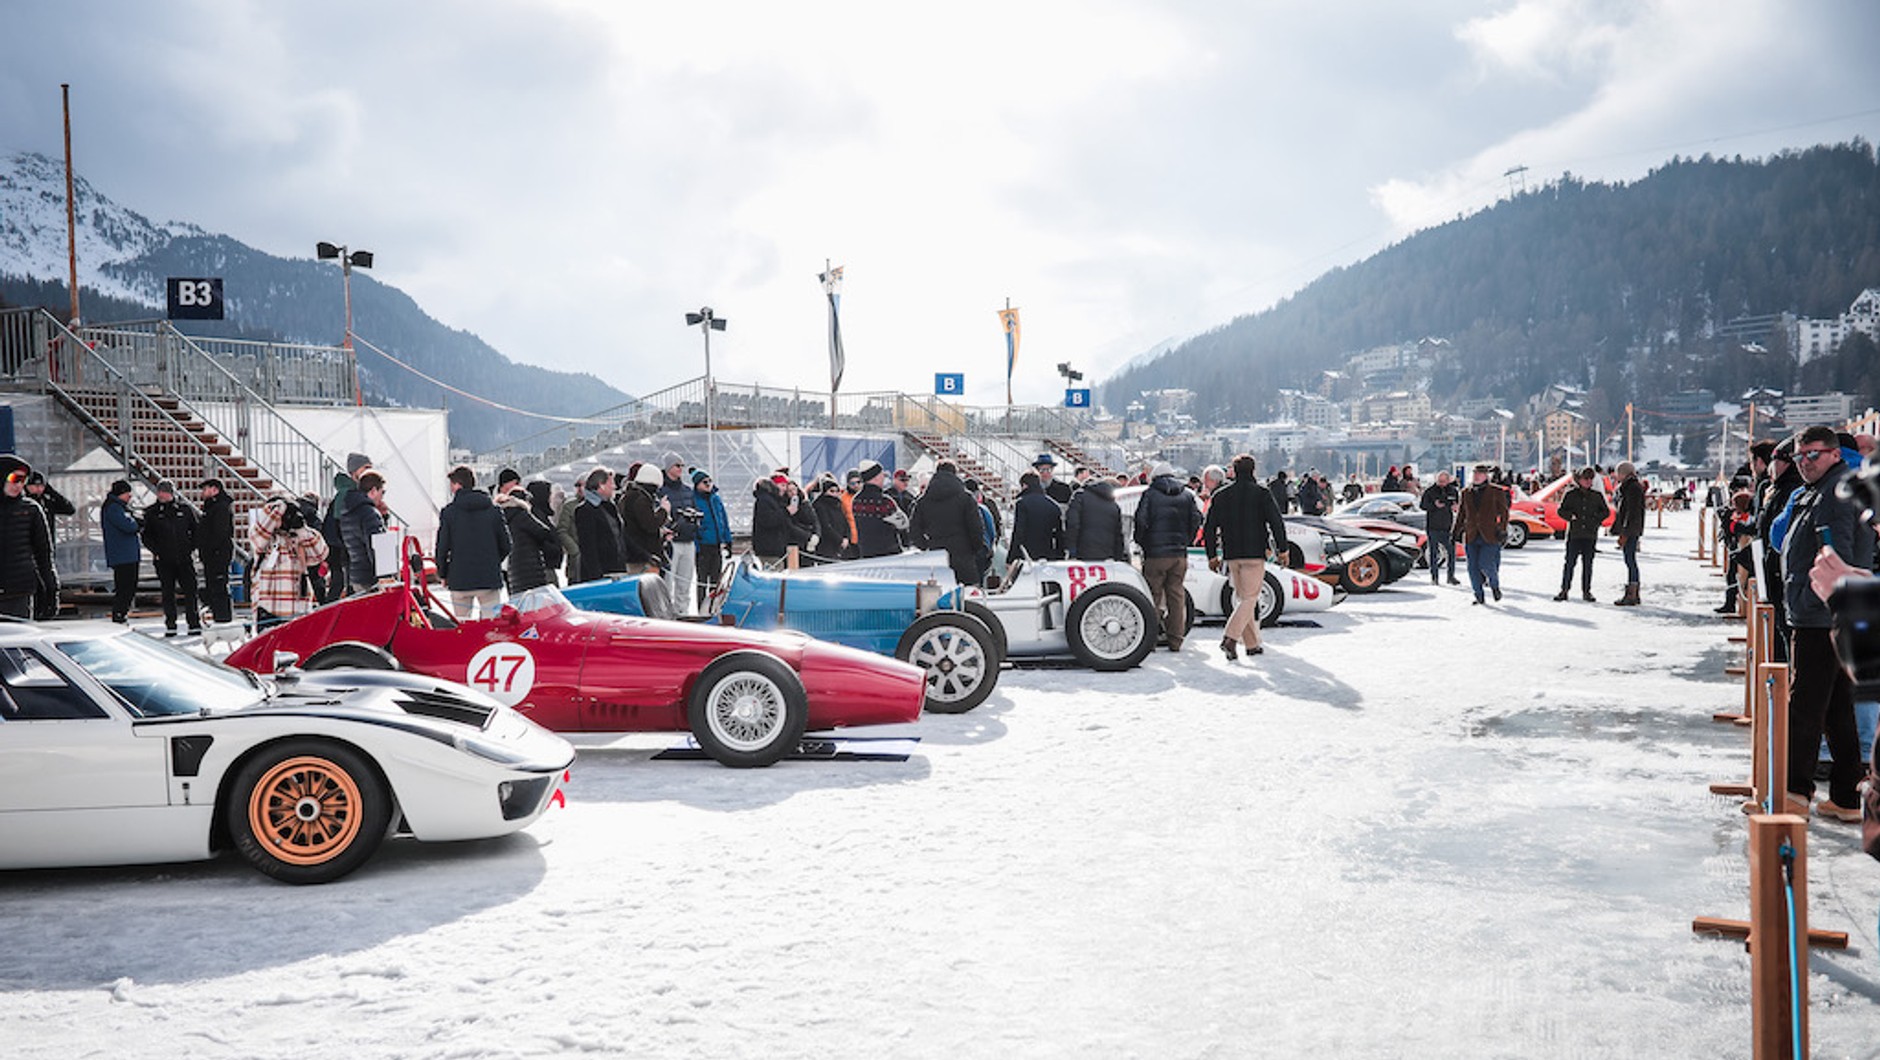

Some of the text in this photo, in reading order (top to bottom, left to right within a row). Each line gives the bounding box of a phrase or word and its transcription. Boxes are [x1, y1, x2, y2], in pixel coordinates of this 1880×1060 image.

[179, 281, 212, 306] B3
[944, 377, 955, 390] B
[1073, 393, 1082, 404] B
[473, 655, 526, 692] 47
